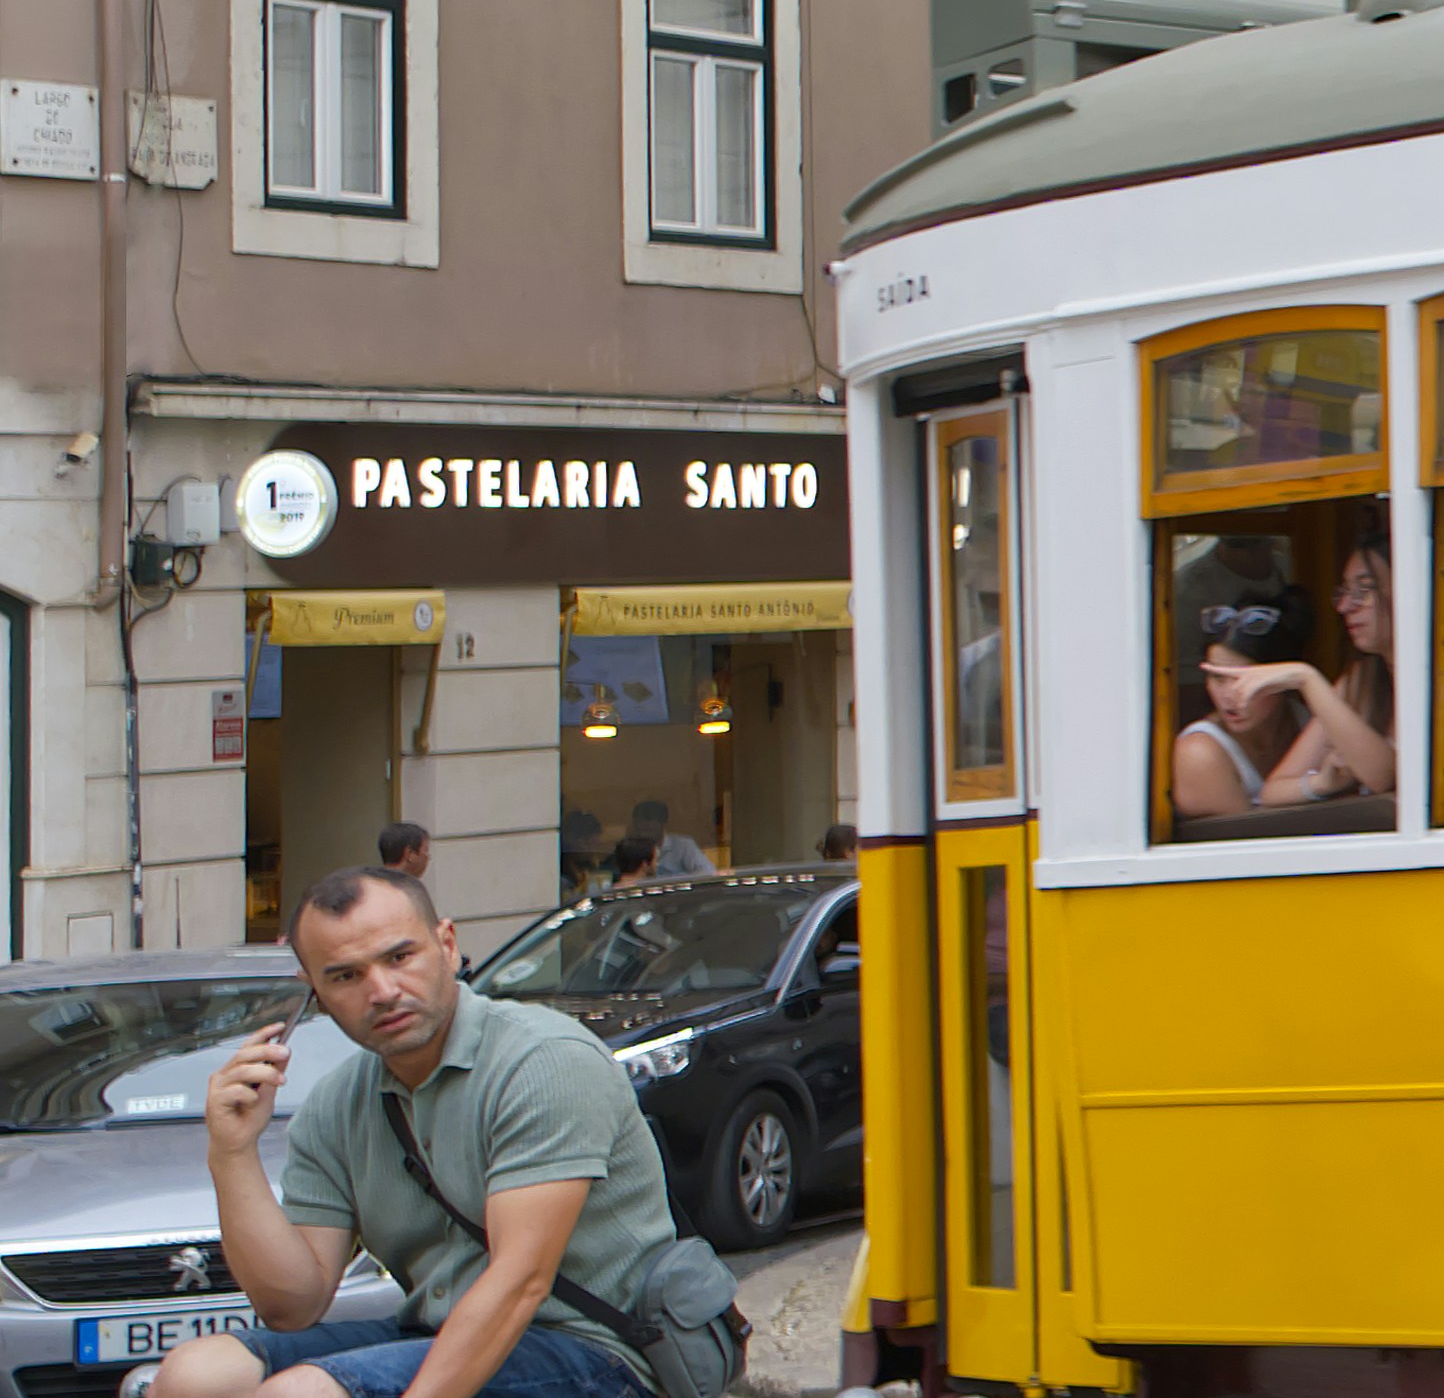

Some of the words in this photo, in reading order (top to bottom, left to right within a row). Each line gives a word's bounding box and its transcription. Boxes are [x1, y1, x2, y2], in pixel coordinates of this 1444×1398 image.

[352, 457, 642, 509] PASTELARIA
[684, 461, 818, 509] SANTO
[332, 606, 395, 631] Premium
[623, 604, 702, 620] PASTELARIA
[710, 602, 752, 618] SANTO
[455, 631, 475, 660] 12
